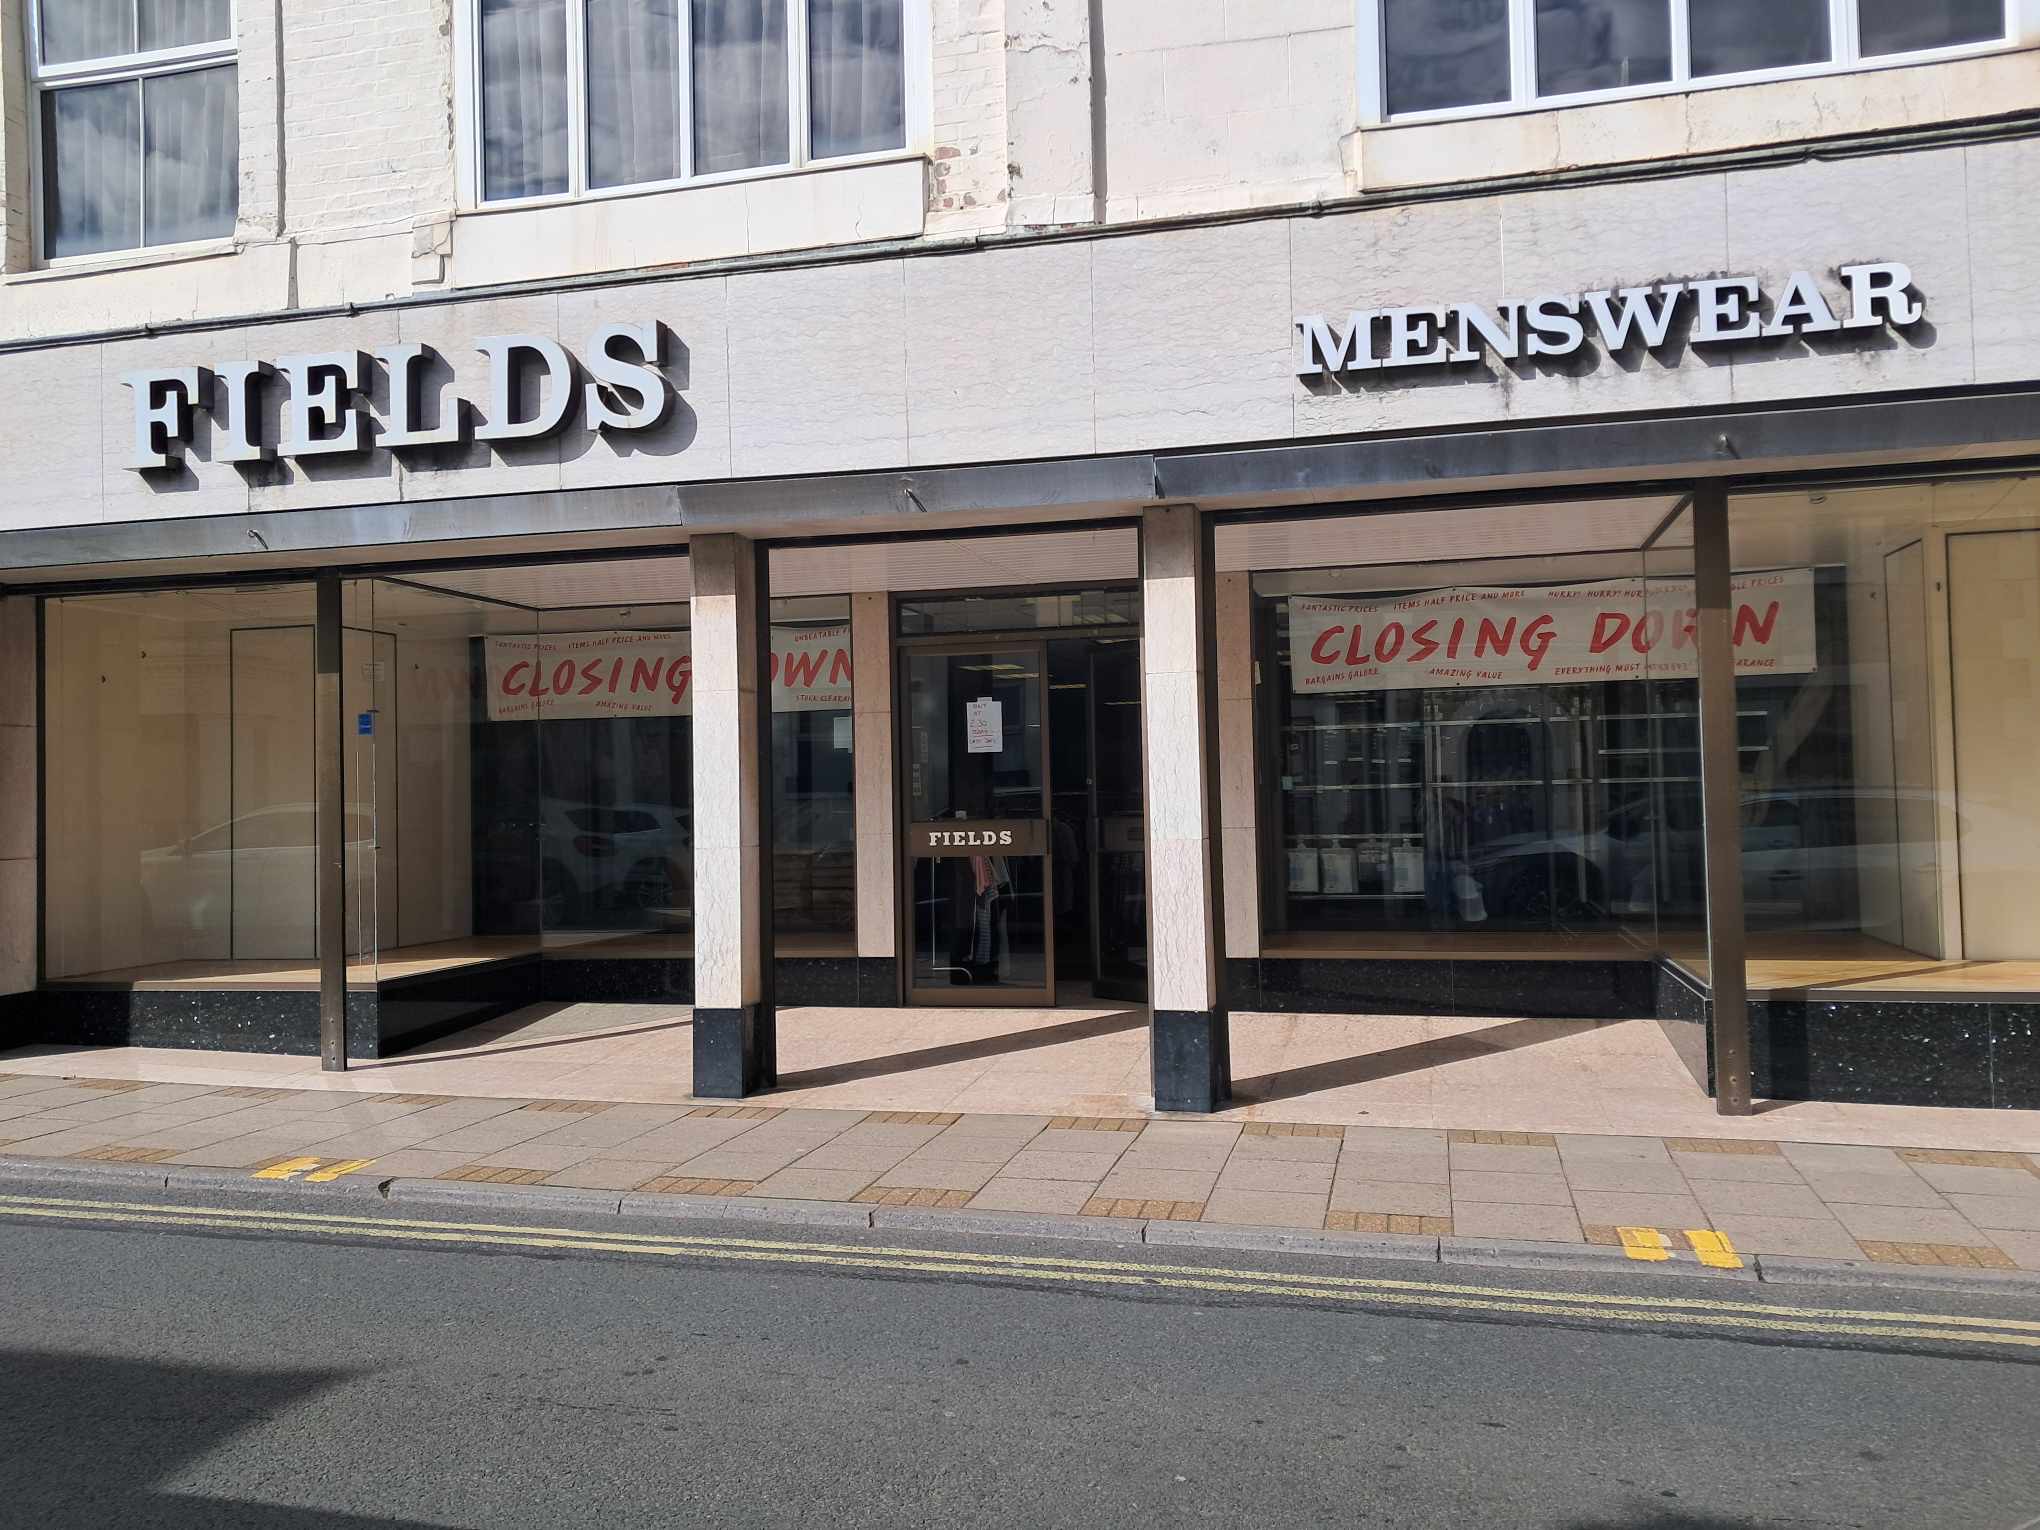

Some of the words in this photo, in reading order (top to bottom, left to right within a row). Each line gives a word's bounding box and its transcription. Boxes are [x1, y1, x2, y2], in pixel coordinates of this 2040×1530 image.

[1296, 261, 1922, 376] MENSWEAR
[121, 320, 667, 471] FIELDS
[1751, 576, 1785, 587] PRICES
[1393, 600, 1421, 611] ITEMS
[1424, 596, 1445, 606] HALF
[1449, 592, 1477, 603] PRICE
[1480, 591, 1499, 600] AND
[1501, 590, 1525, 599] MORE
[611, 636, 633, 645] PRICE
[1311, 614, 1558, 671] CLOSING
[1589, 600, 1780, 654] DON
[1429, 668, 1473, 680] AMAZING
[1476, 670, 1504, 680] VALUE
[1554, 663, 1611, 676] EVERYTHING
[1615, 662, 1641, 672] MUST
[501, 655, 692, 705] CLOSING
[1304, 673, 1345, 686] BARGAINS
[929, 830, 1013, 846] FIELDS
